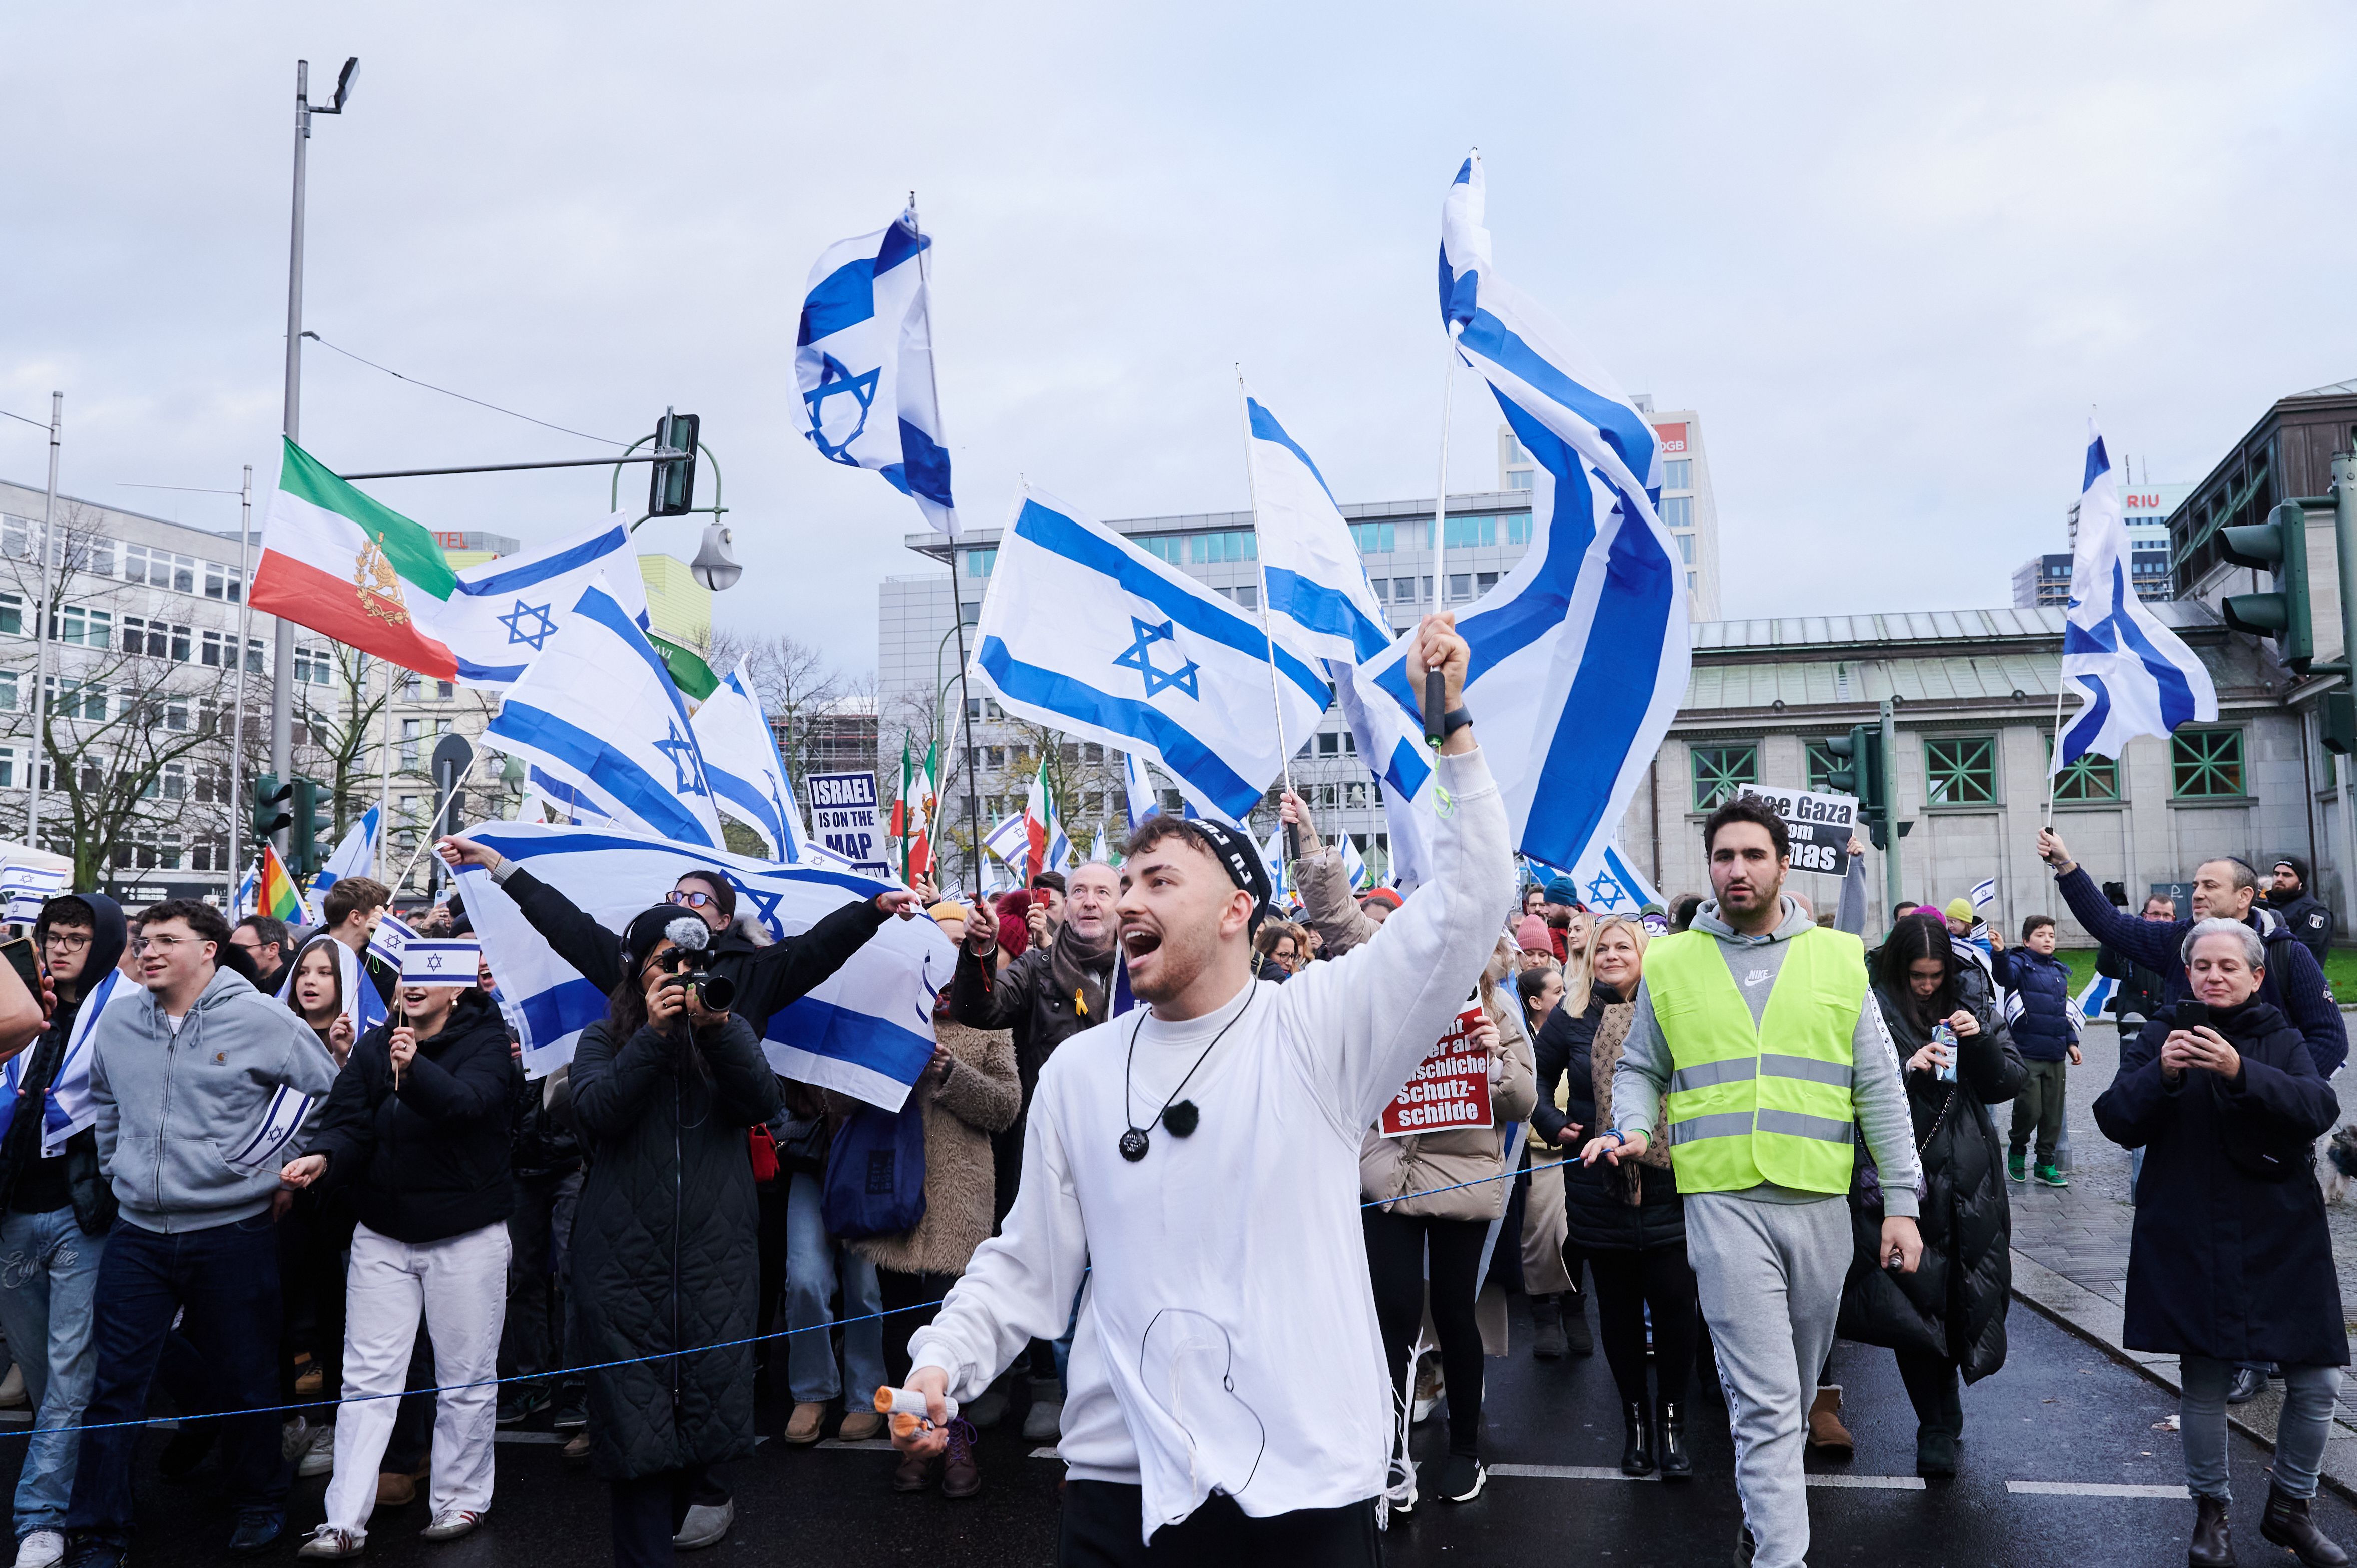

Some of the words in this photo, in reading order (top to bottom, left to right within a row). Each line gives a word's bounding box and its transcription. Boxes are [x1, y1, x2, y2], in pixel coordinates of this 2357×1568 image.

[2127, 494, 2159, 508] RIU
[431, 531, 468, 548] TEL
[812, 778, 873, 805] ISRAEL
[819, 812, 830, 828] IS
[832, 811, 848, 827] ON
[851, 810, 874, 826] THE
[1796, 796, 1852, 825] Gaza
[1786, 823, 1814, 841] om
[826, 833, 872, 860] MAP
[1789, 842, 1836, 871] mas
[942, 882, 960, 901] ISRAEL
[1748, 969, 1769, 980] NIKE
[1452, 1034, 1471, 1053] al
[1409, 1054, 1486, 1082] schliche
[1398, 1100, 1478, 1127] schilde
